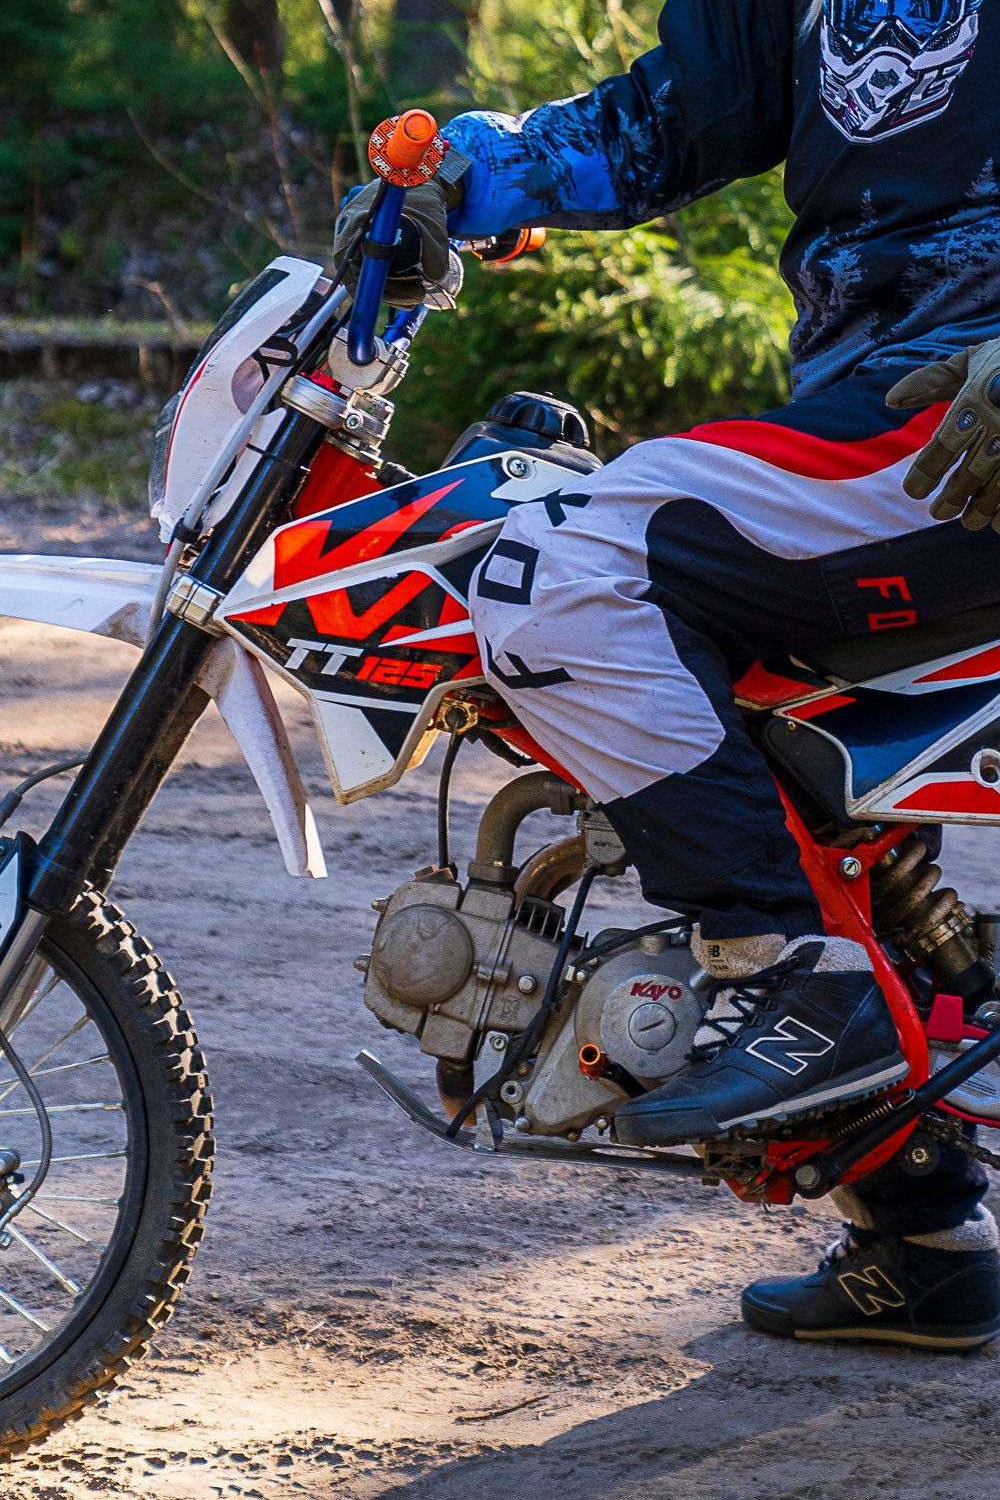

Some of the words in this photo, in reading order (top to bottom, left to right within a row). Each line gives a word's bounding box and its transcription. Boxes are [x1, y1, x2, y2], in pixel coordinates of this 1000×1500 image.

[856, 575, 916, 632] FO
[629, 979, 683, 1001] KAYO
[745, 1015, 836, 1076] N
[837, 1265, 906, 1316] N
